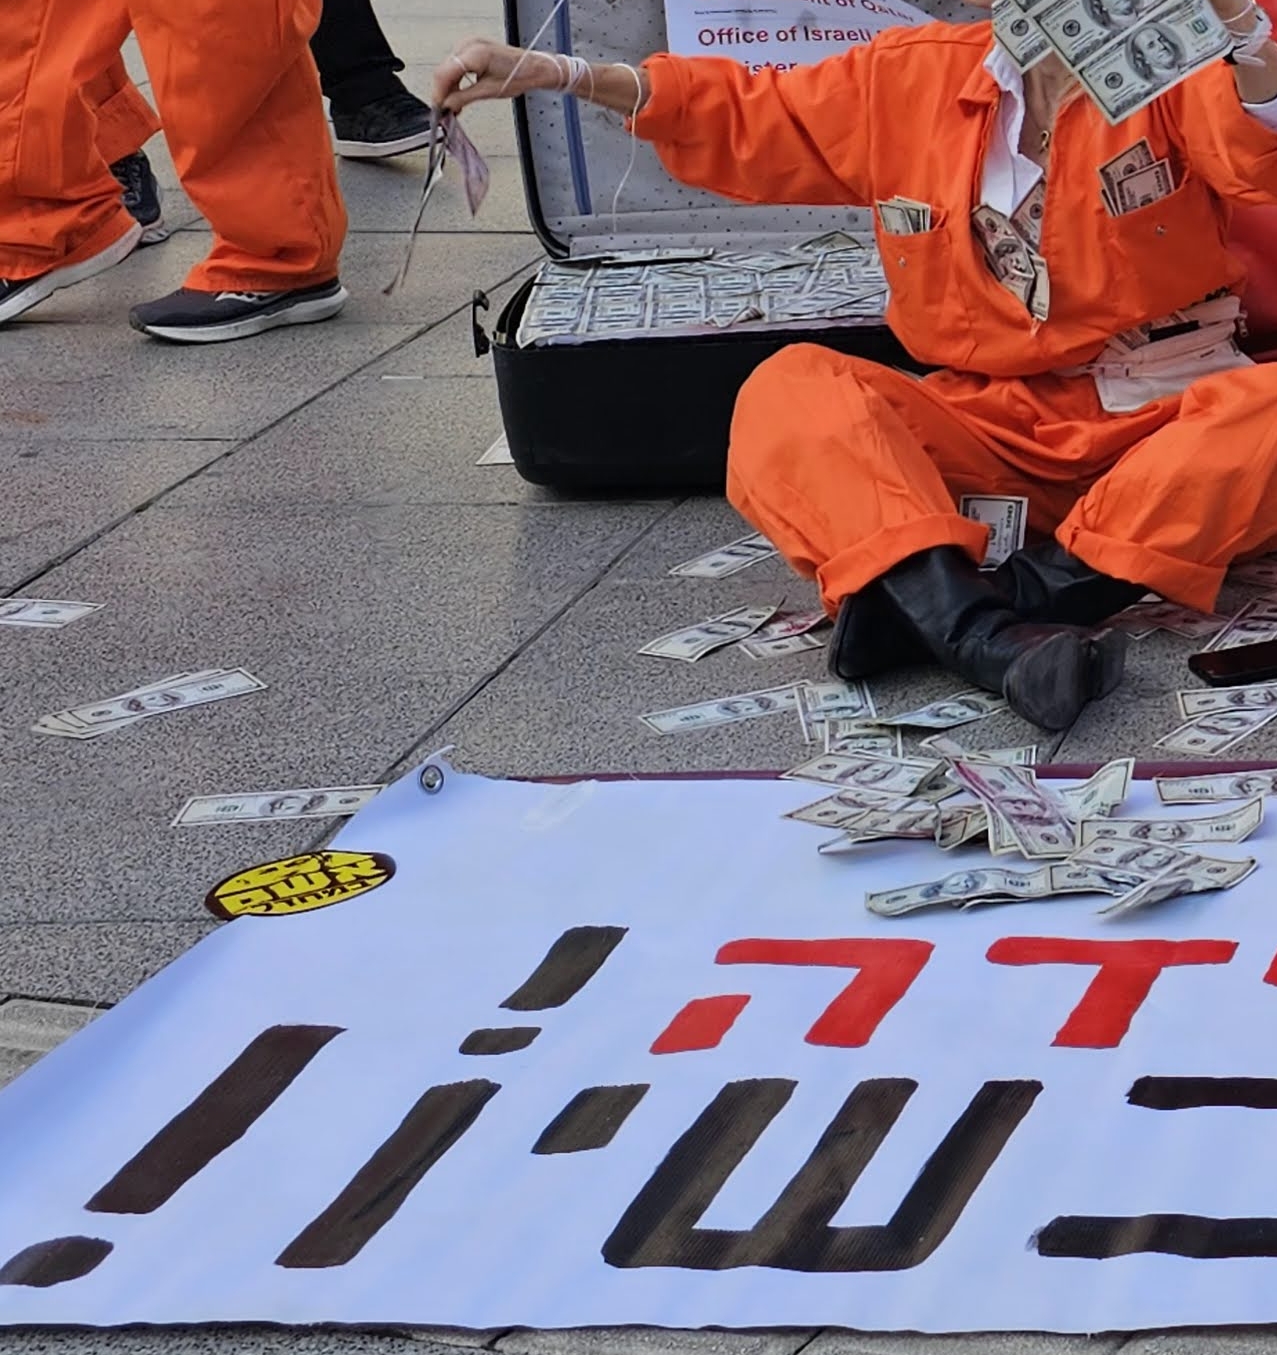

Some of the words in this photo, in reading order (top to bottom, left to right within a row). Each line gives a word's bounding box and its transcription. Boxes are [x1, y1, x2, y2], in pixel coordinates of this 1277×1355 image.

[698, 28, 768, 46] Office
[776, 26, 798, 42] of
[804, 25, 871, 42] Israeli
